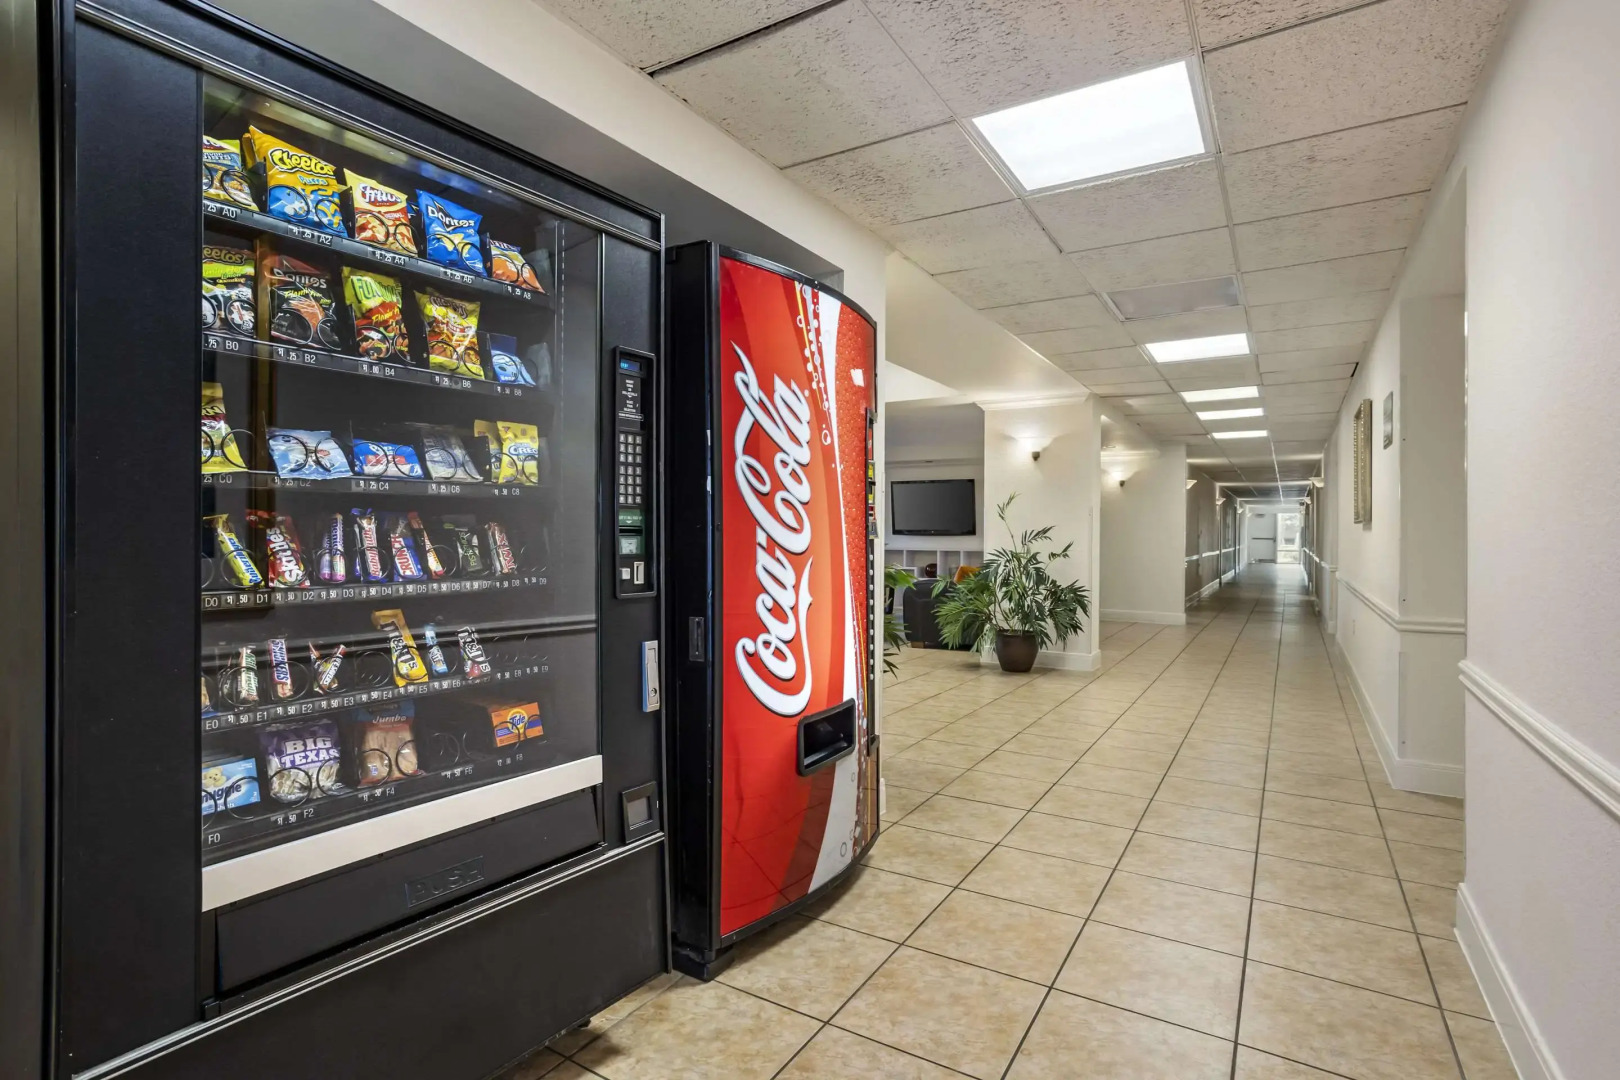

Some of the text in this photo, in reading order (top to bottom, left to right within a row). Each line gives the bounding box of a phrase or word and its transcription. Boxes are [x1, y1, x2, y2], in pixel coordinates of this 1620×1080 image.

[269, 148, 334, 175] Cheetos
[298, 175, 327, 185] Puffs
[360, 183, 402, 203] Fritos
[222, 207, 237, 218] A0
[427, 206, 475, 227] Doritos
[319, 235, 331, 245] A2
[395, 256, 404, 265] A4
[273, 268, 328, 289] Doritos
[463, 275, 472, 284] A6
[523, 291, 531, 300] A8
[225, 341, 239, 351] B0
[304, 353, 316, 363] B2
[385, 367, 395, 376] B4
[462, 380, 471, 388] B6
[509, 444, 538, 455] OREO
[219, 474, 233, 484] C0
[379, 482, 389, 490] C4
[451, 485, 460, 494] C6
[511, 488, 520, 496] C8
[730, 341, 814, 718] Coca-Cola
[267, 527, 304, 582] Skittles
[391, 534, 415, 577] CRUNCH
[451, 583, 460, 591] D6
[512, 579, 520, 587] D8
[343, 588, 354, 598] D3
[382, 587, 392, 596] D4
[417, 585, 427, 593] D5
[256, 593, 268, 604] D1
[302, 591, 314, 601] D2
[205, 597, 218, 607] D0
[272, 640, 290, 681] SNICKERS
[541, 665, 549, 673] E9
[452, 680, 461, 688] E6
[383, 691, 392, 699] E4
[344, 698, 354, 707] E3
[302, 704, 313, 714] E2
[256, 711, 267, 721] E1
[372, 713, 407, 724] Jumbo
[206, 719, 219, 730] E0
[509, 714, 525, 730] Tide
[285, 737, 332, 755] BIG
[281, 750, 340, 768] TEXAS
[464, 767, 473, 775] F6
[386, 788, 395, 797] F4
[303, 808, 314, 818] F2
[208, 833, 221, 845] F0
[411, 867, 482, 904] PUSH
